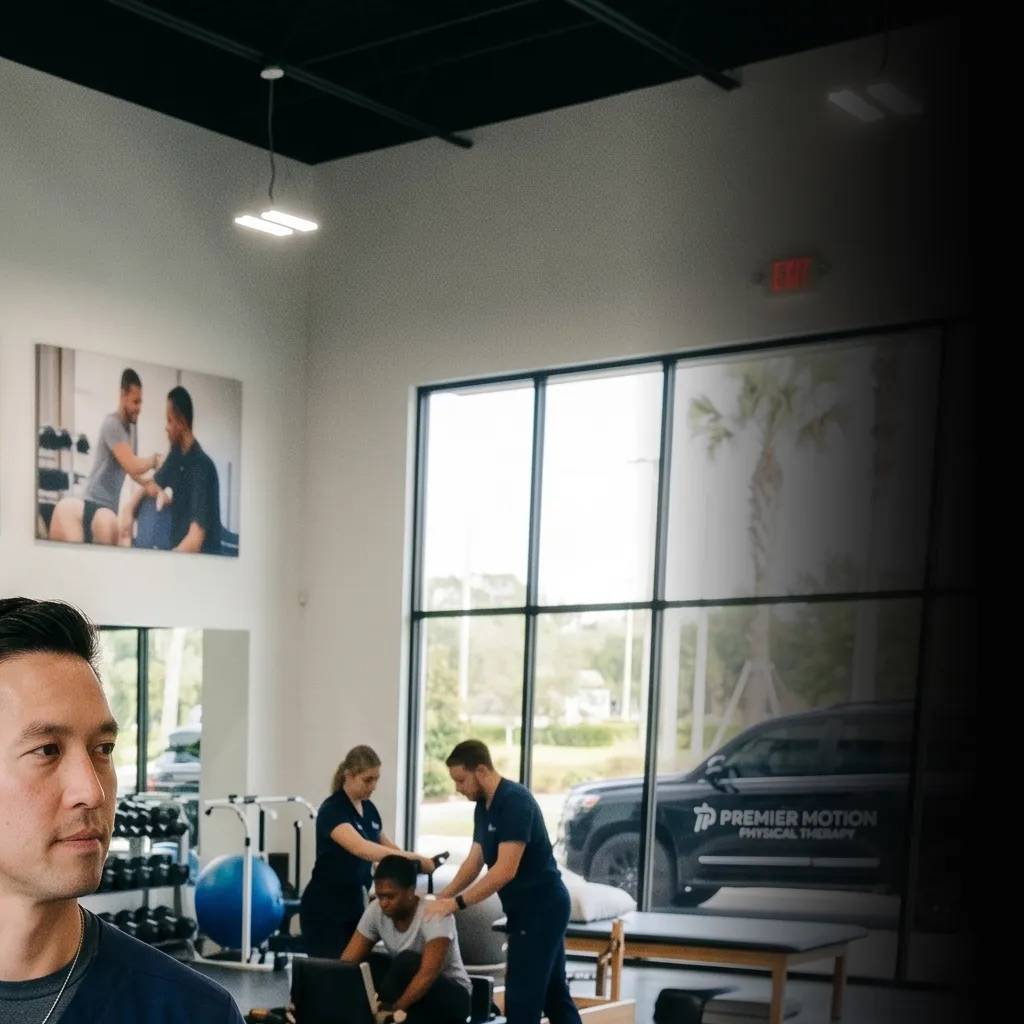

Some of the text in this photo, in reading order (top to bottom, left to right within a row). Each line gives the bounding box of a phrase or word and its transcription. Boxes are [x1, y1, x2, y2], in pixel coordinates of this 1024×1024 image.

[719, 809, 878, 827] PREMIER MOTION
[738, 827, 798, 840] PHYSICAL
